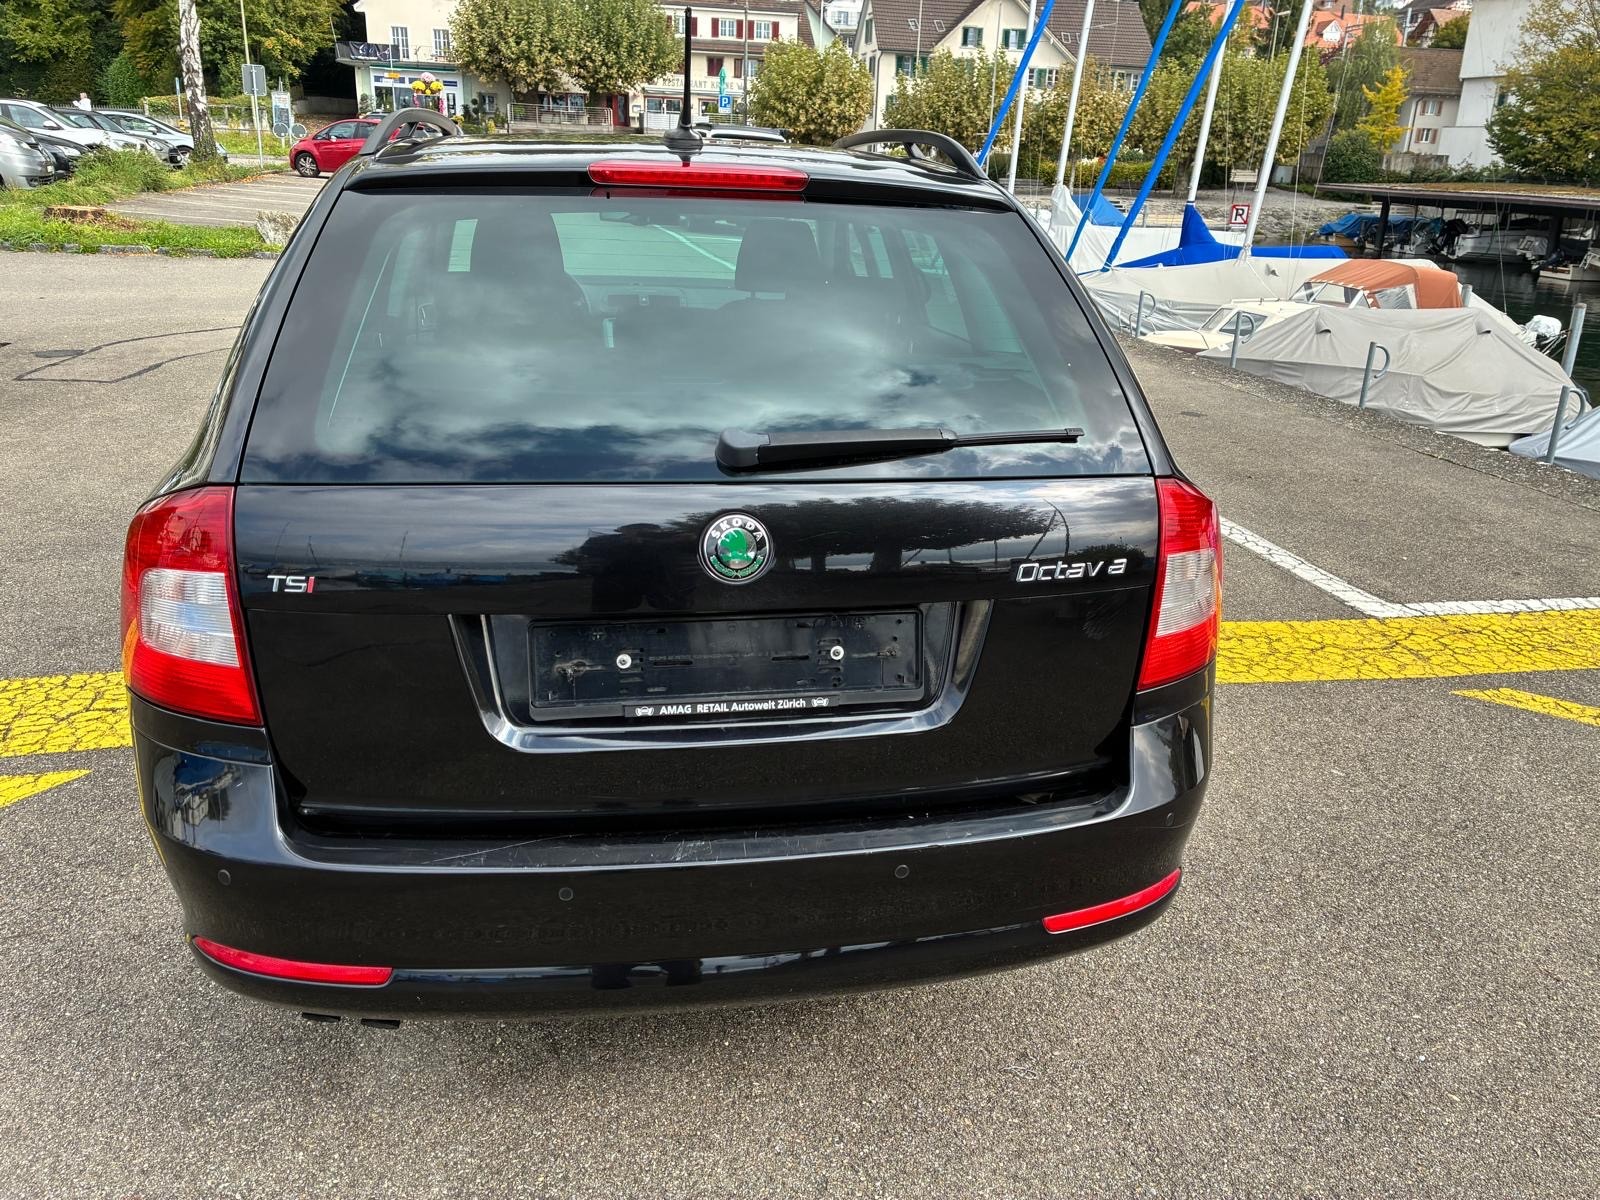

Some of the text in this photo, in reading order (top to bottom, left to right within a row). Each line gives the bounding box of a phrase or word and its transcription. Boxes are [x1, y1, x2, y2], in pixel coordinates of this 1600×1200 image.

[662, 78, 707, 90] RESTARANT
[710, 81, 734, 91] KRNE
[721, 97, 728, 107] P
[266, 574, 315, 594] TSI
[659, 698, 807, 715] AMAG RETAIL Autowelt Zürich
